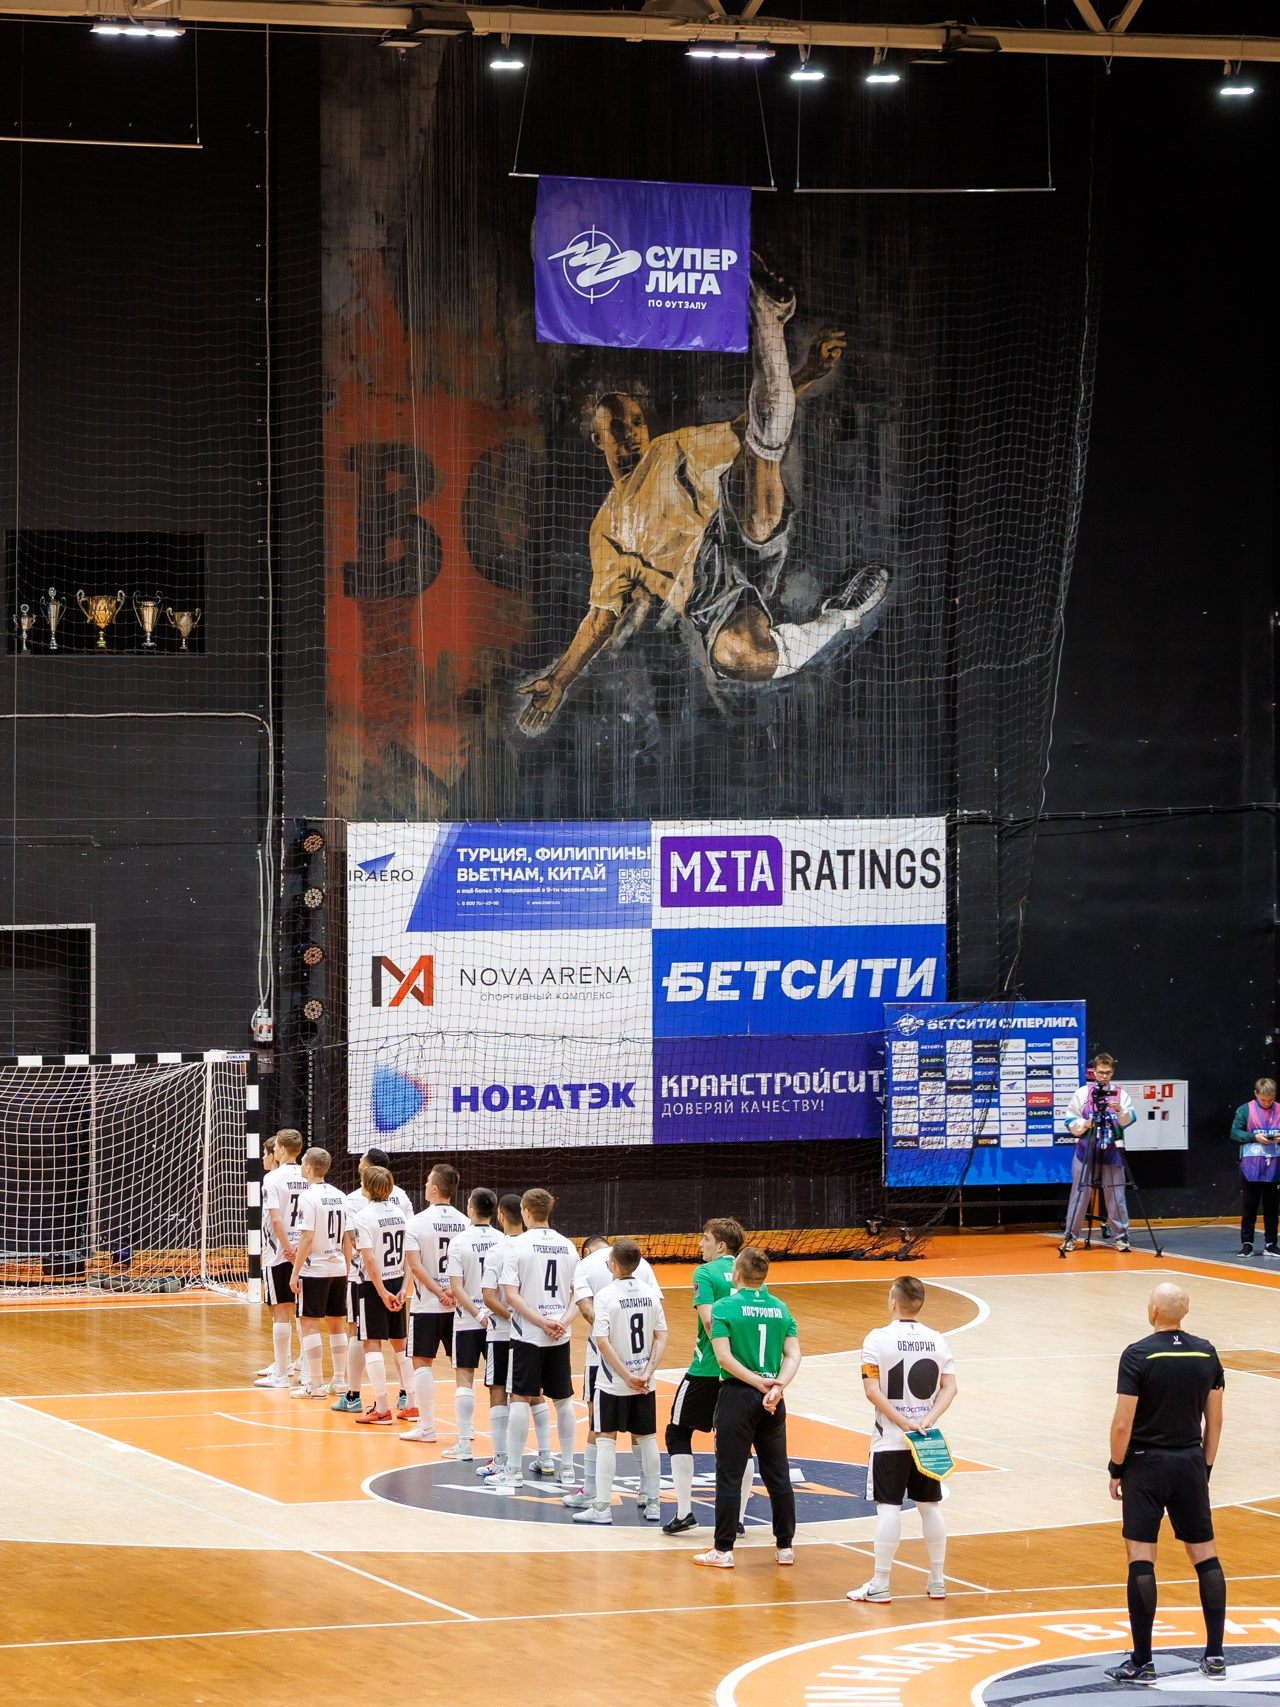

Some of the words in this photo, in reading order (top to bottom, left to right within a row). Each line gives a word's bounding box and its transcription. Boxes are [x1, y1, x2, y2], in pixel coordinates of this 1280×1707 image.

[645, 245, 738, 271] СУПЕР
[645, 271, 721, 295] ЛИГА
[648, 299, 662, 307] ПО
[665, 299, 707, 310] ФУТЗАЛУ
[456, 847, 532, 864] ТУРЦИЯ,
[535, 846, 651, 862] ФИЛИППИНЫ
[349, 869, 414, 882] IRAERO
[457, 867, 544, 884] ВЬЕТНАМ,
[548, 863, 606, 881] КИТАЙ
[790, 847, 941, 891] RATINGS
[460, 967, 533, 986] NOVA
[541, 966, 632, 984] ARENA
[662, 957, 937, 1002] БЕТСИТИ
[481, 991, 553, 1001] СПОРТИВНЫЙ
[556, 991, 613, 1000] КОМПЛЕКС
[927, 1018, 997, 1030] БЕТСИТИ
[999, 1016, 1078, 1029] СУПЕРЛИГА
[661, 1066, 884, 1098] КРАНСТРОЙСИТ
[452, 1082, 636, 1112] НОВАТЭК
[661, 1098, 734, 1118] ДОВЕРЯЙ
[740, 1097, 825, 1114] КАЧЕСТВУ!
[382, 1229, 405, 1268] 29
[544, 1259, 558, 1298] 4
[629, 1313, 644, 1354] 8
[758, 1323, 767, 1368] 1
[897, 1340, 936, 1352] ОБЖОРИН
[887, 1357, 940, 1401] 10
